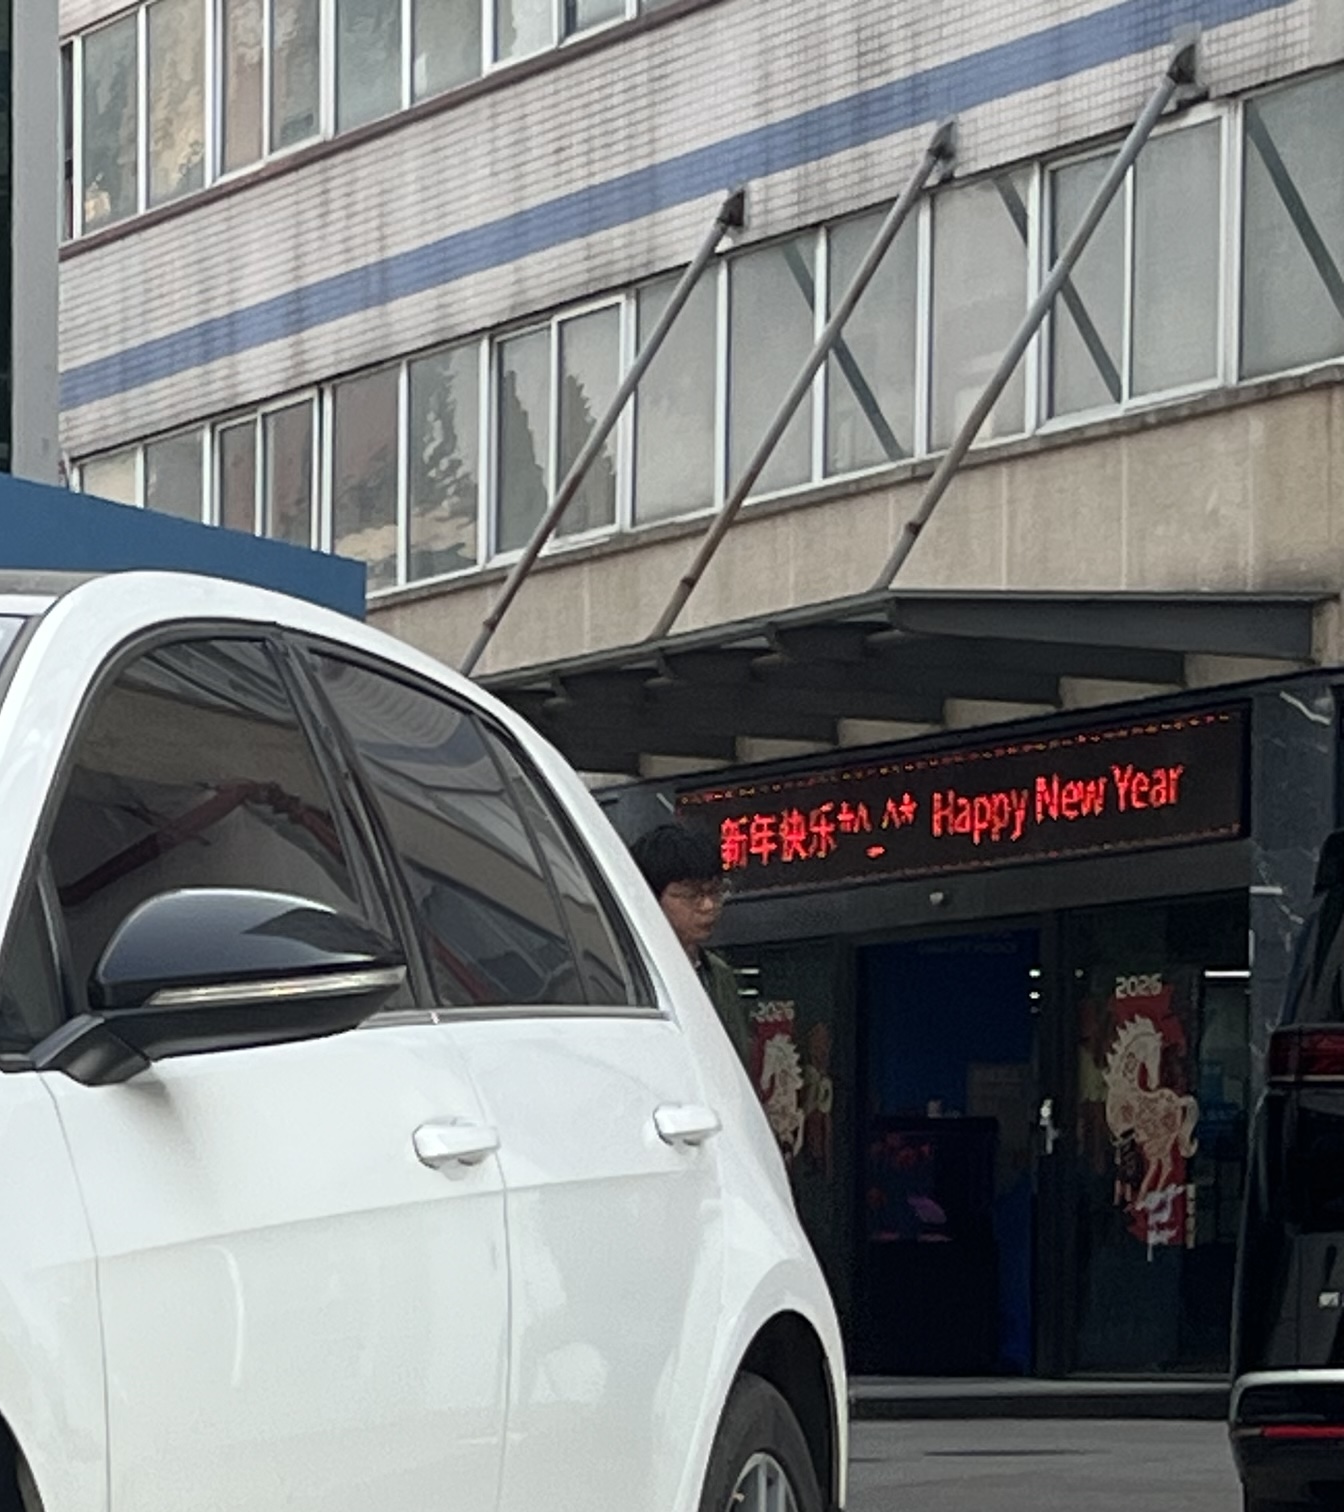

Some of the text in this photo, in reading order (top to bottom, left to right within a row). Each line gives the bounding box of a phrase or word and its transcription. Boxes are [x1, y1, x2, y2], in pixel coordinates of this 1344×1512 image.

[932, 789, 1029, 845] Happy
[1035, 773, 1107, 824] New
[1112, 764, 1184, 812] Year
[1115, 972, 1163, 999] 2026
